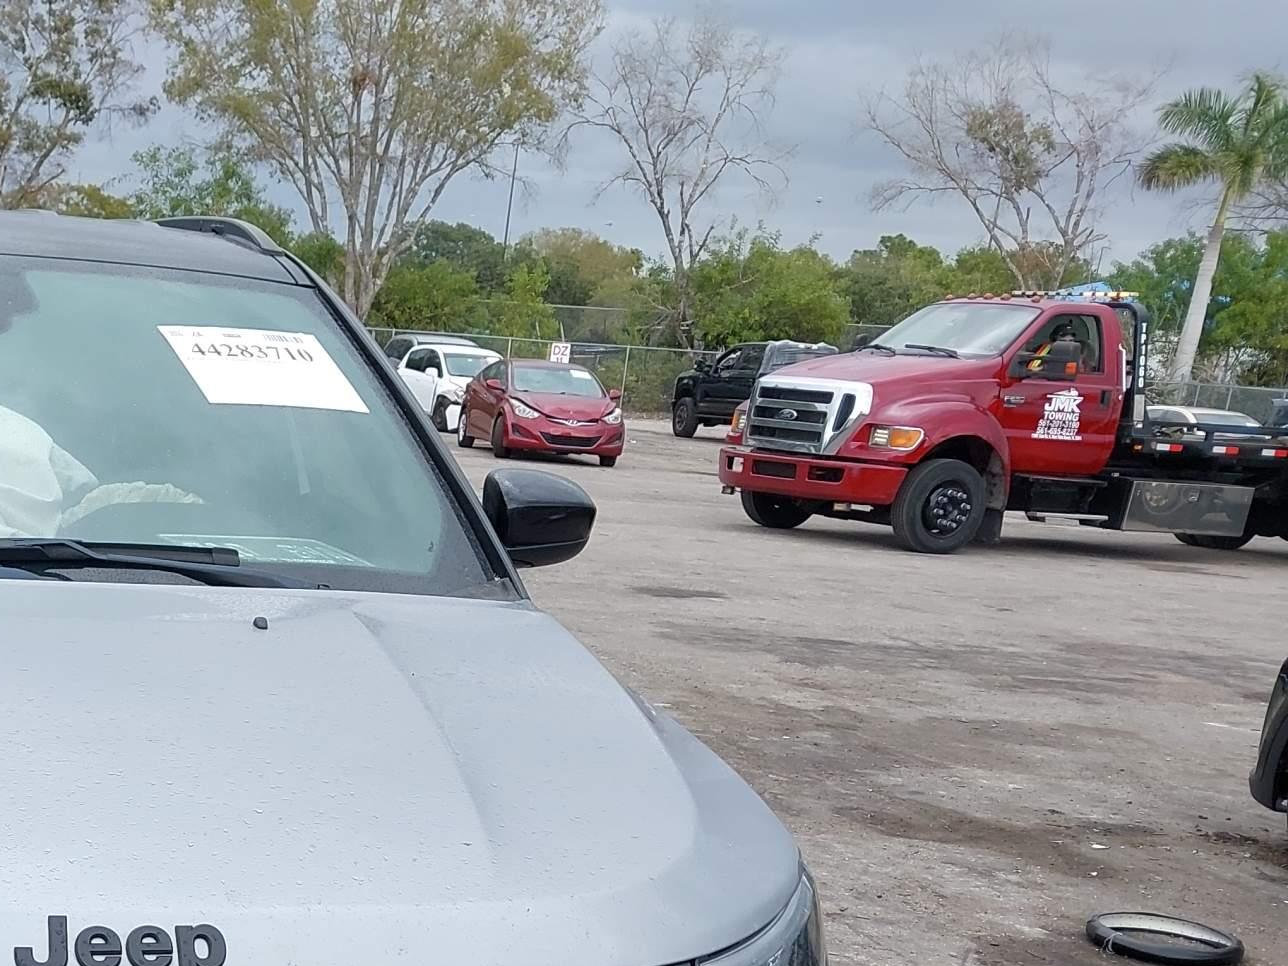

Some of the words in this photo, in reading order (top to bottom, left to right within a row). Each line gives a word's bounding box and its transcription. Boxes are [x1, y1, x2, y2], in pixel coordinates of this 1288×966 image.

[190, 342, 314, 362] 44283710
[553, 345, 569, 356] DZ
[1138, 322, 1148, 388] TP1060
[1044, 397, 1083, 412] JMK
[1044, 411, 1080, 422] TOWING
